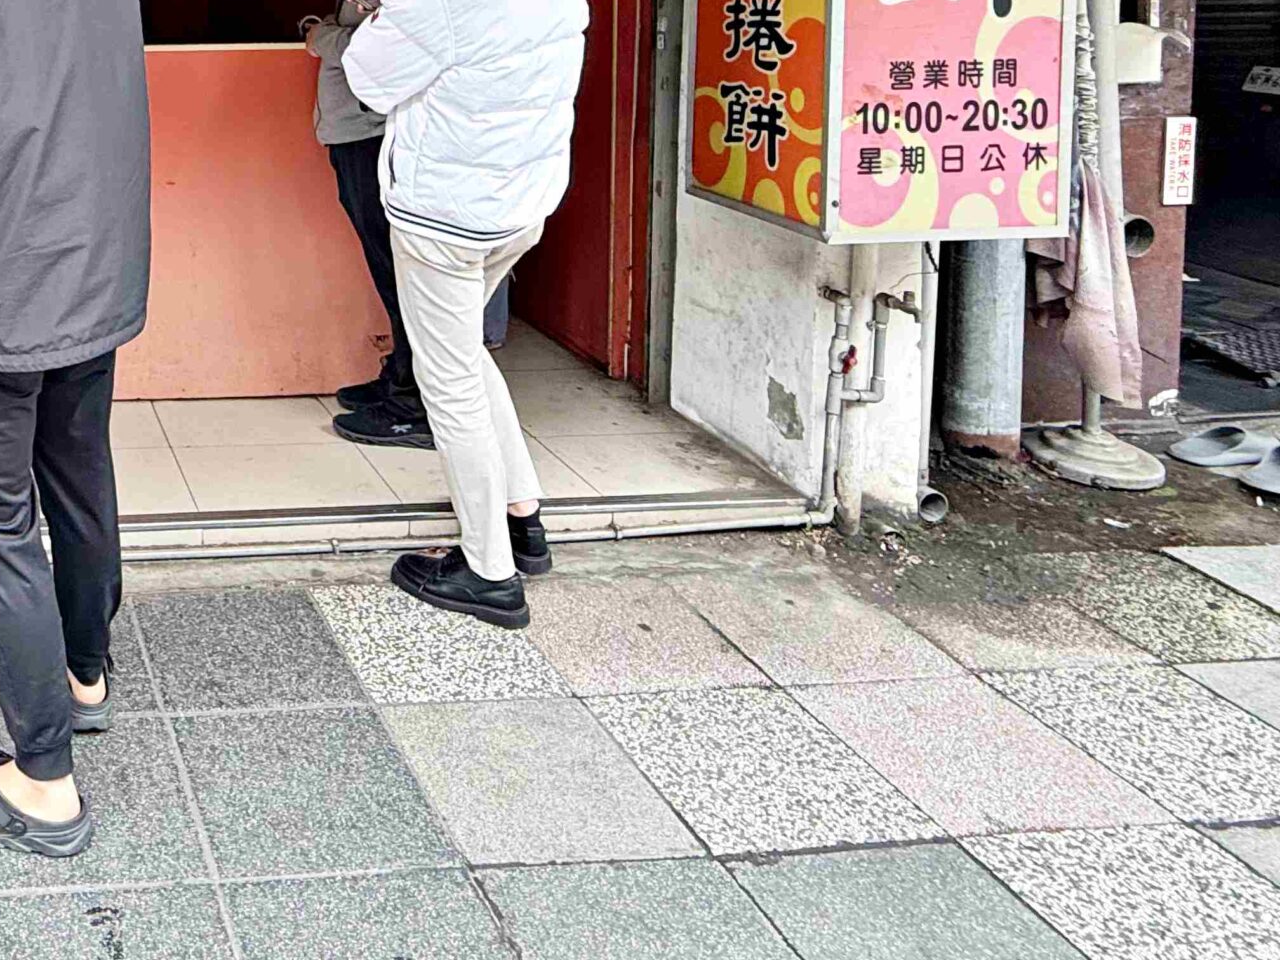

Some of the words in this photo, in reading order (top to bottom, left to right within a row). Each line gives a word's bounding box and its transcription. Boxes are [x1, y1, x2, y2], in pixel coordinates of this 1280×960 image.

[889, 58, 1018, 90] 營業時間
[857, 97, 1048, 135] 10:00~20:30
[857, 143, 1048, 175] 星期日公休
